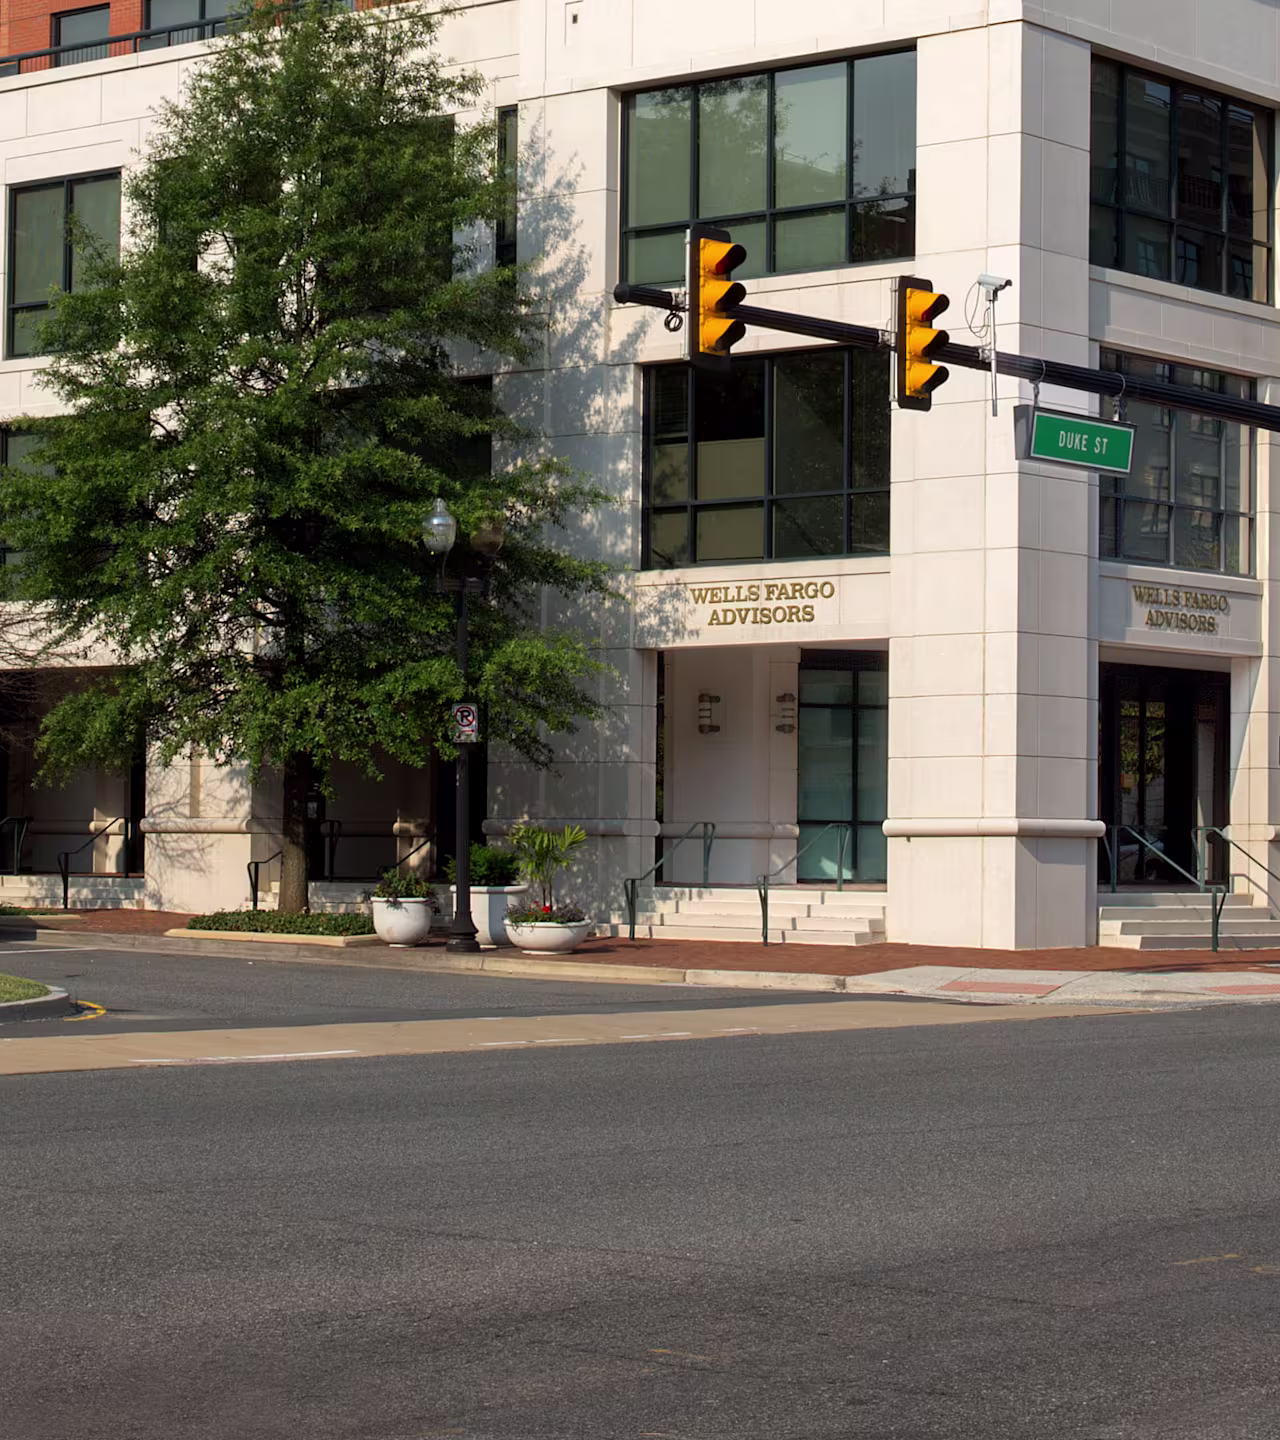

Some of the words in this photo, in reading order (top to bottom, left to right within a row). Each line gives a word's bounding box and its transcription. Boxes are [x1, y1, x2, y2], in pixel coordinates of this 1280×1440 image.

[1058, 430, 1088, 451] DUKE
[1094, 437, 1108, 455] ST
[690, 585, 760, 605] WELLS
[764, 581, 835, 601] FARGO
[1132, 585, 1180, 607] WELLS
[1183, 591, 1229, 612] FARGO
[708, 605, 815, 626] ADVISORS
[1145, 610, 1216, 633] ADVISORS
